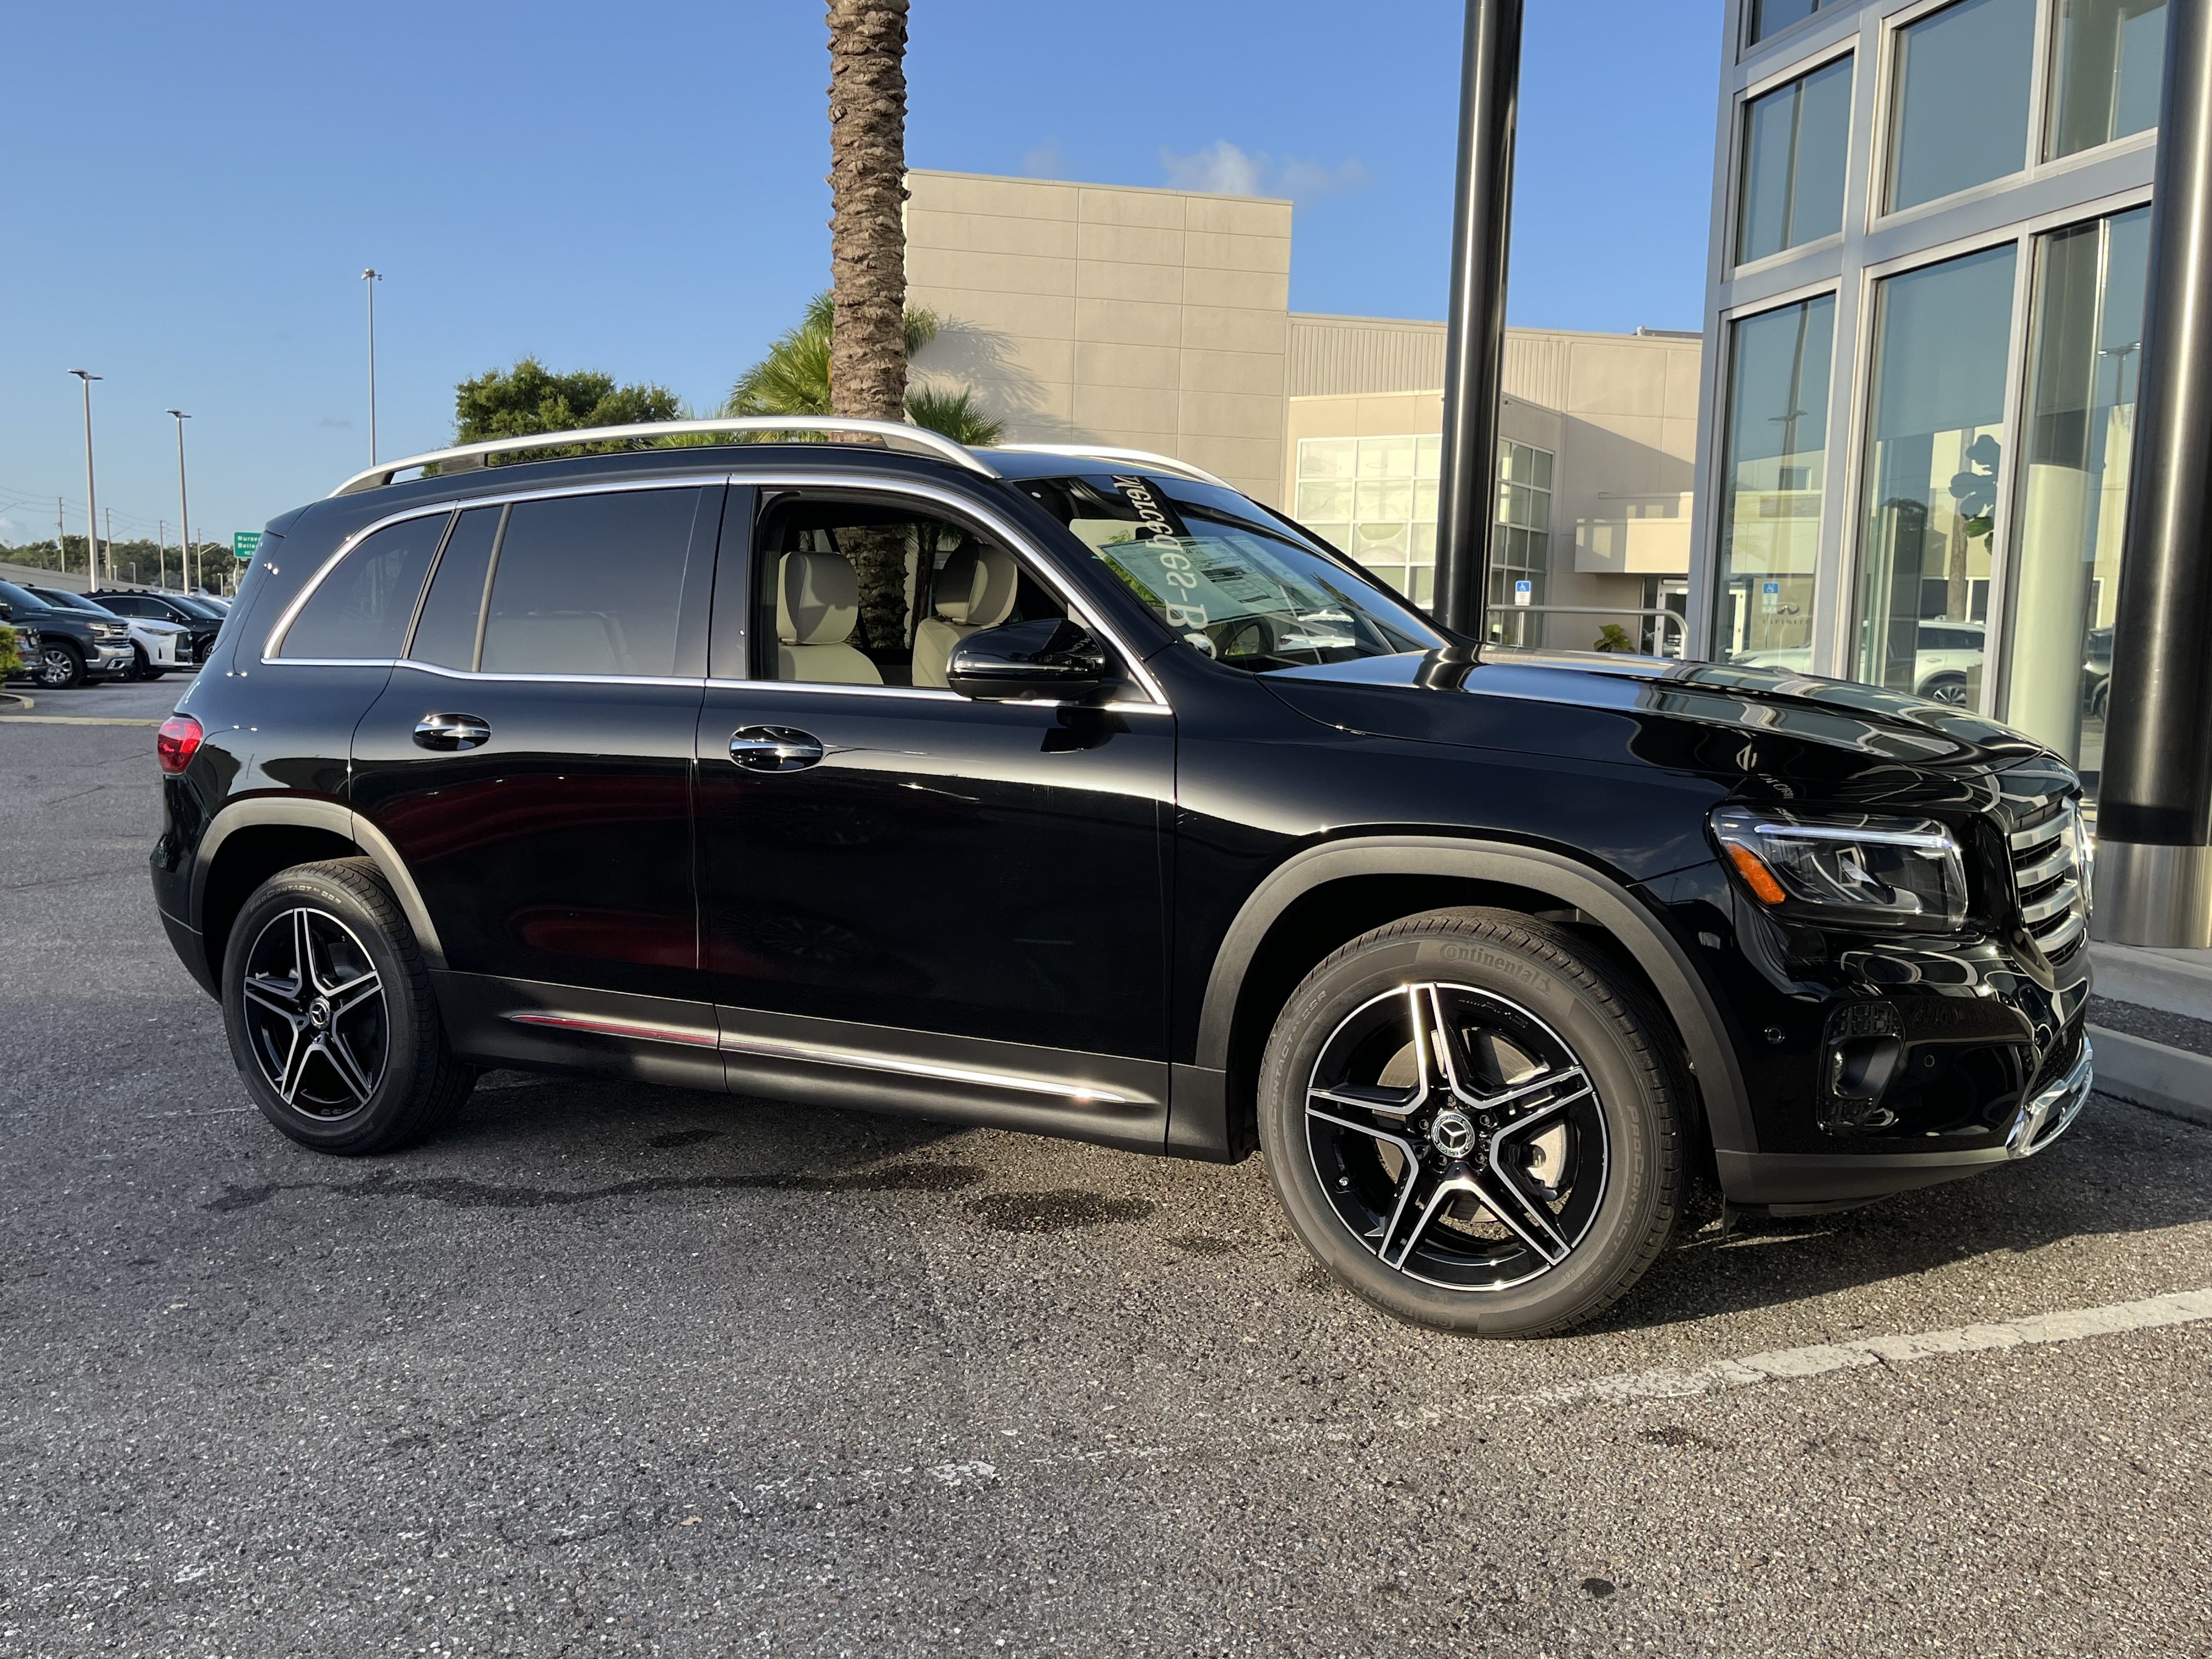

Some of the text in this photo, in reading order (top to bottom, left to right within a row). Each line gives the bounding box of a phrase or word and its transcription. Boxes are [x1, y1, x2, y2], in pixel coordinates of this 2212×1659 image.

[1440, 944, 1541, 986] Continental
[1301, 990, 1328, 1021] SSR
[1572, 1264, 1604, 1295] SSR
[1361, 1283, 1455, 1329] Continental
